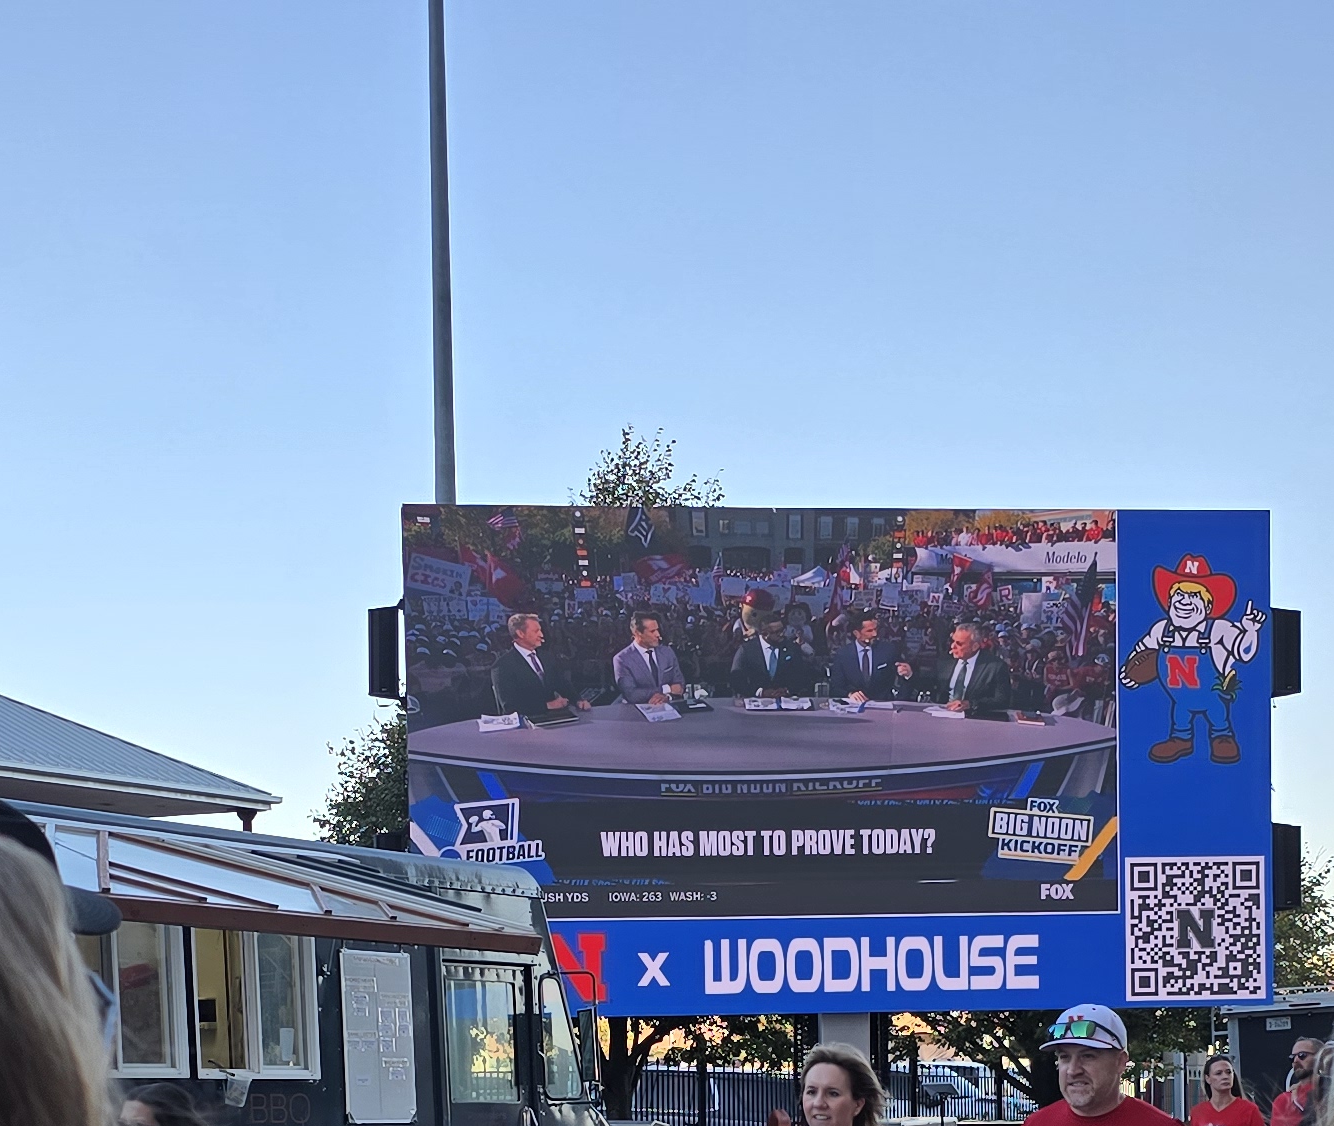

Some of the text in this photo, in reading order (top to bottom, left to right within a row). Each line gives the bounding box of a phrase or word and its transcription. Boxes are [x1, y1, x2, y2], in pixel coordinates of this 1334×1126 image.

[1044, 551, 1087, 565] Modelo
[1185, 560, 1199, 574] N
[1167, 656, 1200, 688] N
[1030, 800, 1057, 813] FOX
[994, 812, 1088, 840] BIG NOON
[467, 840, 544, 863] FOOTBALL
[600, 828, 936, 857] WHO HAS MOST TO PROVE TODAY?
[1000, 838, 1081, 857] KICKOFF
[565, 892, 589, 903] YDS
[609, 892, 641, 903] IOWA:
[643, 892, 663, 902] 263
[670, 891, 705, 902] WASH:
[706, 891, 718, 902] -3
[1040, 883, 1074, 899] FOX
[1175, 908, 1216, 949] N
[703, 934, 1040, 995] WOODHOUSE
[249, 1093, 311, 1126] BBQ
